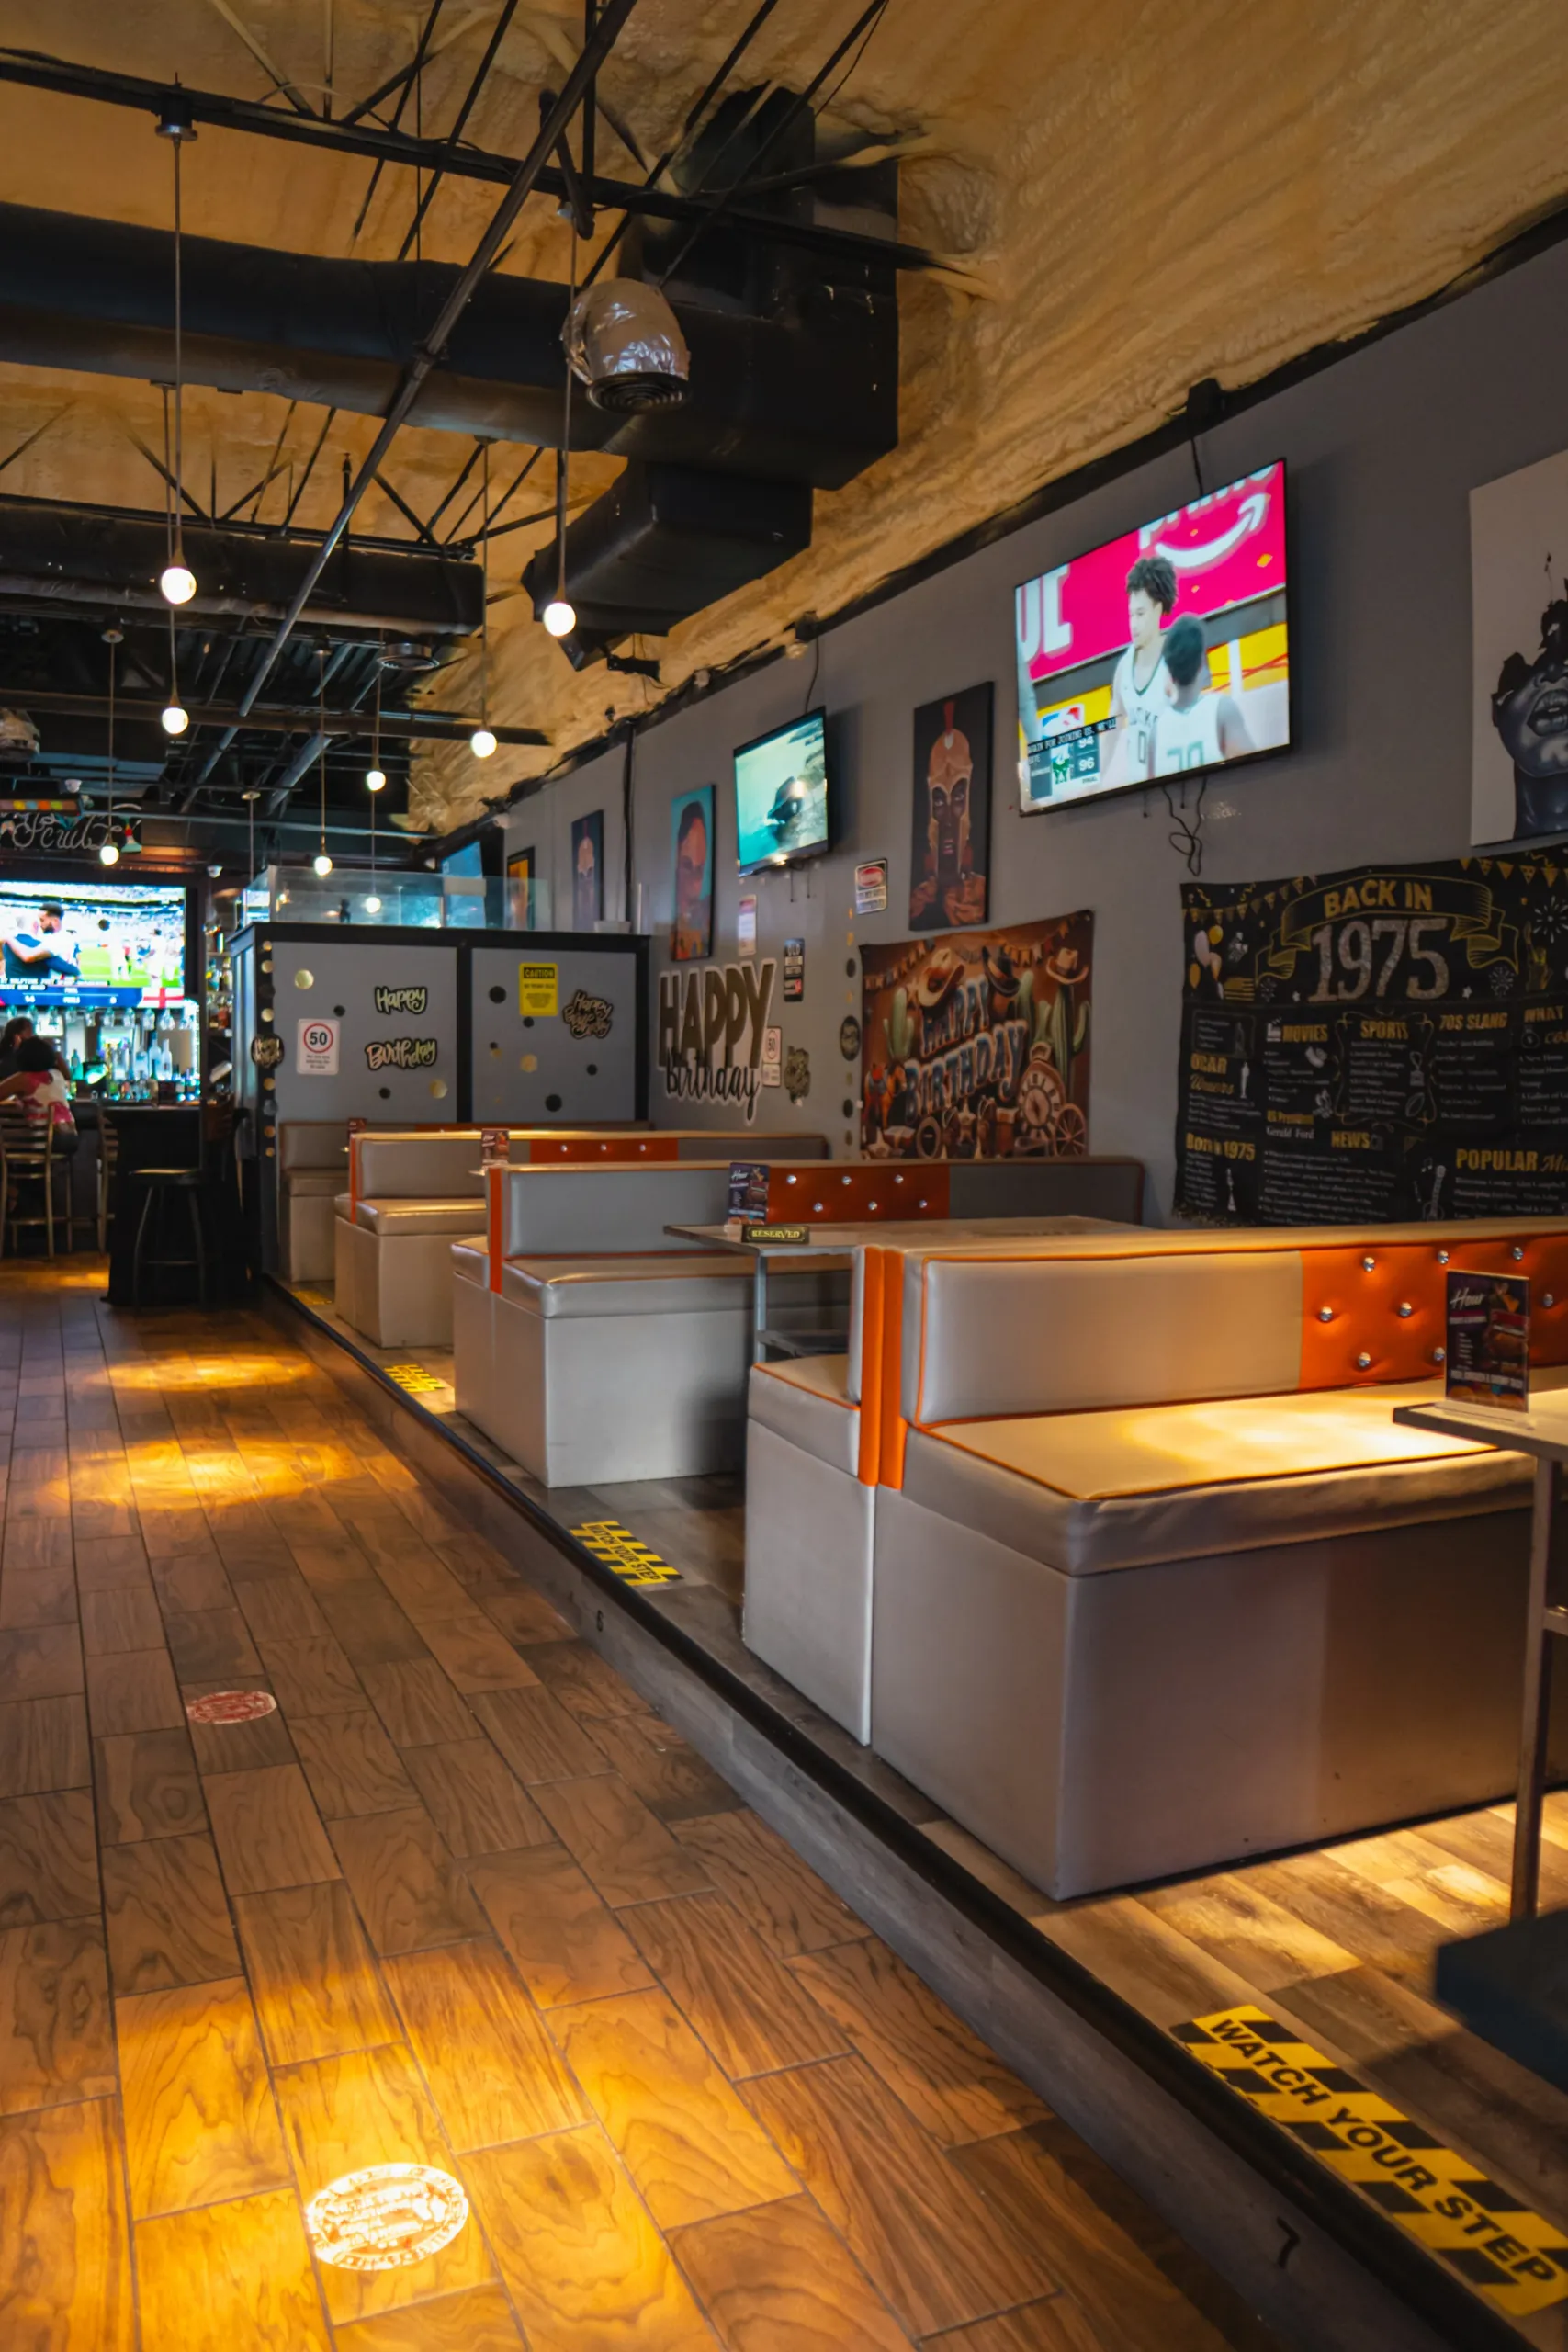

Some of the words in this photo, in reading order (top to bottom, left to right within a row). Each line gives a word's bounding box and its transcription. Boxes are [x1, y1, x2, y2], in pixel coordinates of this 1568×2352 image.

[1078, 757, 1095, 772] 96
[1324, 879, 1397, 918] BACK
[1404, 881, 1433, 911] IN
[1307, 918, 1449, 1003] 1975
[525, 968, 555, 978] CAUTION
[375, 986, 427, 1014] Happy
[659, 964, 774, 1069] HAPPY
[1466, 1012, 1508, 1030] SLANG
[1524, 1005, 1564, 1023] WHAT
[310, 1031, 328, 1046] 50
[1282, 1024, 1328, 1042] MOVIES
[1359, 1019, 1409, 1039] SPORTS
[366, 1038, 436, 1069] Birthday
[904, 1020, 1027, 1125] BIRTHDAY
[667, 1046, 761, 1121] birthday
[1295, 1128, 1314, 1139] Ford
[1331, 1130, 1371, 1149] NEWS
[1224, 1141, 1256, 1161] 1975
[1455, 1148, 1539, 1172] POPULAR
[751, 1229, 800, 1239] RESERVED
[1450, 1287, 1487, 1309] Hour
[610, 1544, 641, 1563] YOUR
[630, 1563, 662, 1580] STEP
[1209, 2019, 1330, 2106] WATCH
[1326, 2107, 1438, 2192] YOUR
[1433, 2195, 1558, 2282] STEP
